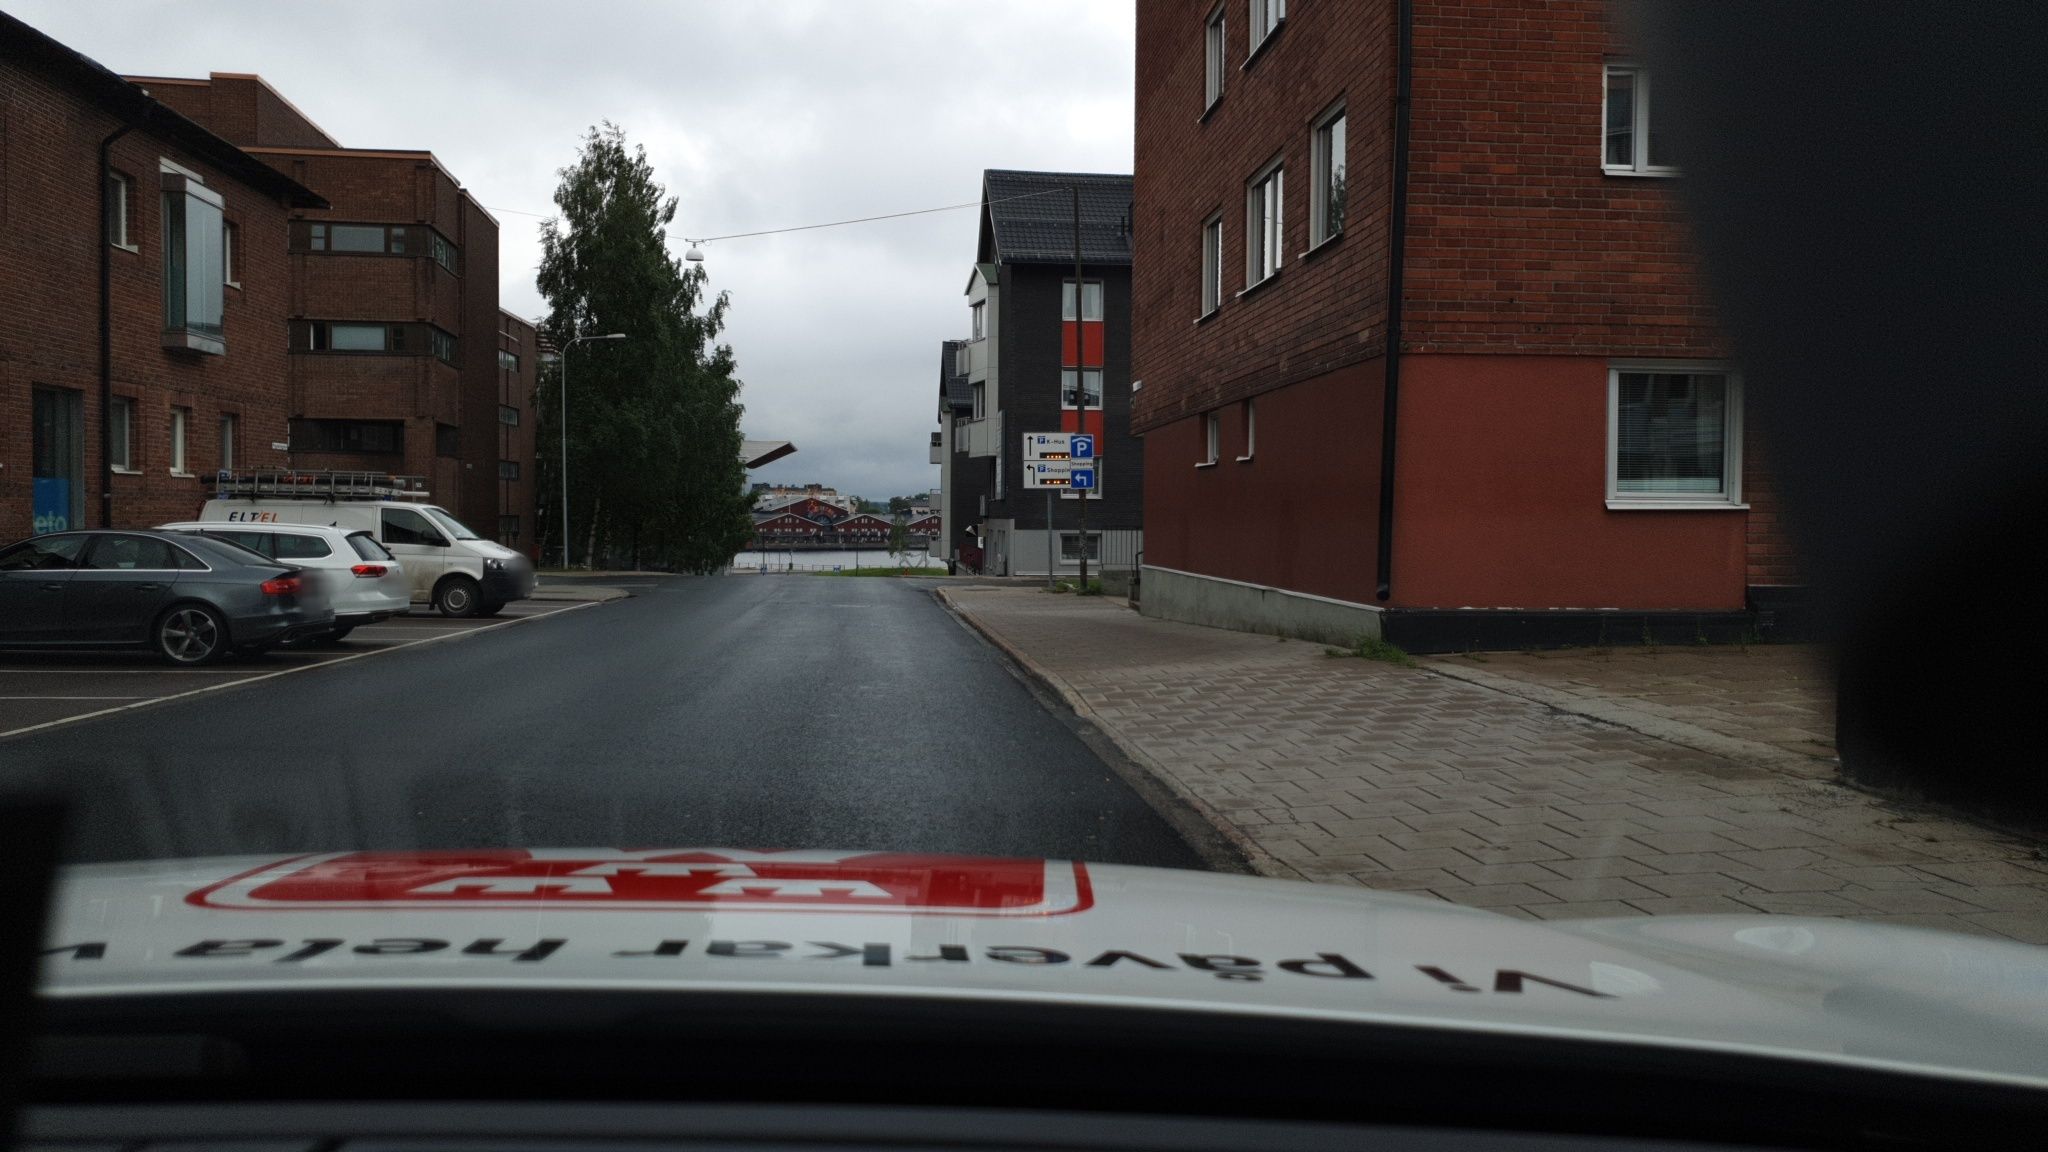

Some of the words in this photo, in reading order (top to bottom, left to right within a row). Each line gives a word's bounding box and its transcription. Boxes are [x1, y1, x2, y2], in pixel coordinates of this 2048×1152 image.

[1077, 442, 1087, 456] P
[229, 511, 279, 523] ELTEL
[173, 938, 568, 966] hela
[612, 939, 1374, 984] påverkar
[1410, 964, 1620, 1001] Vi
